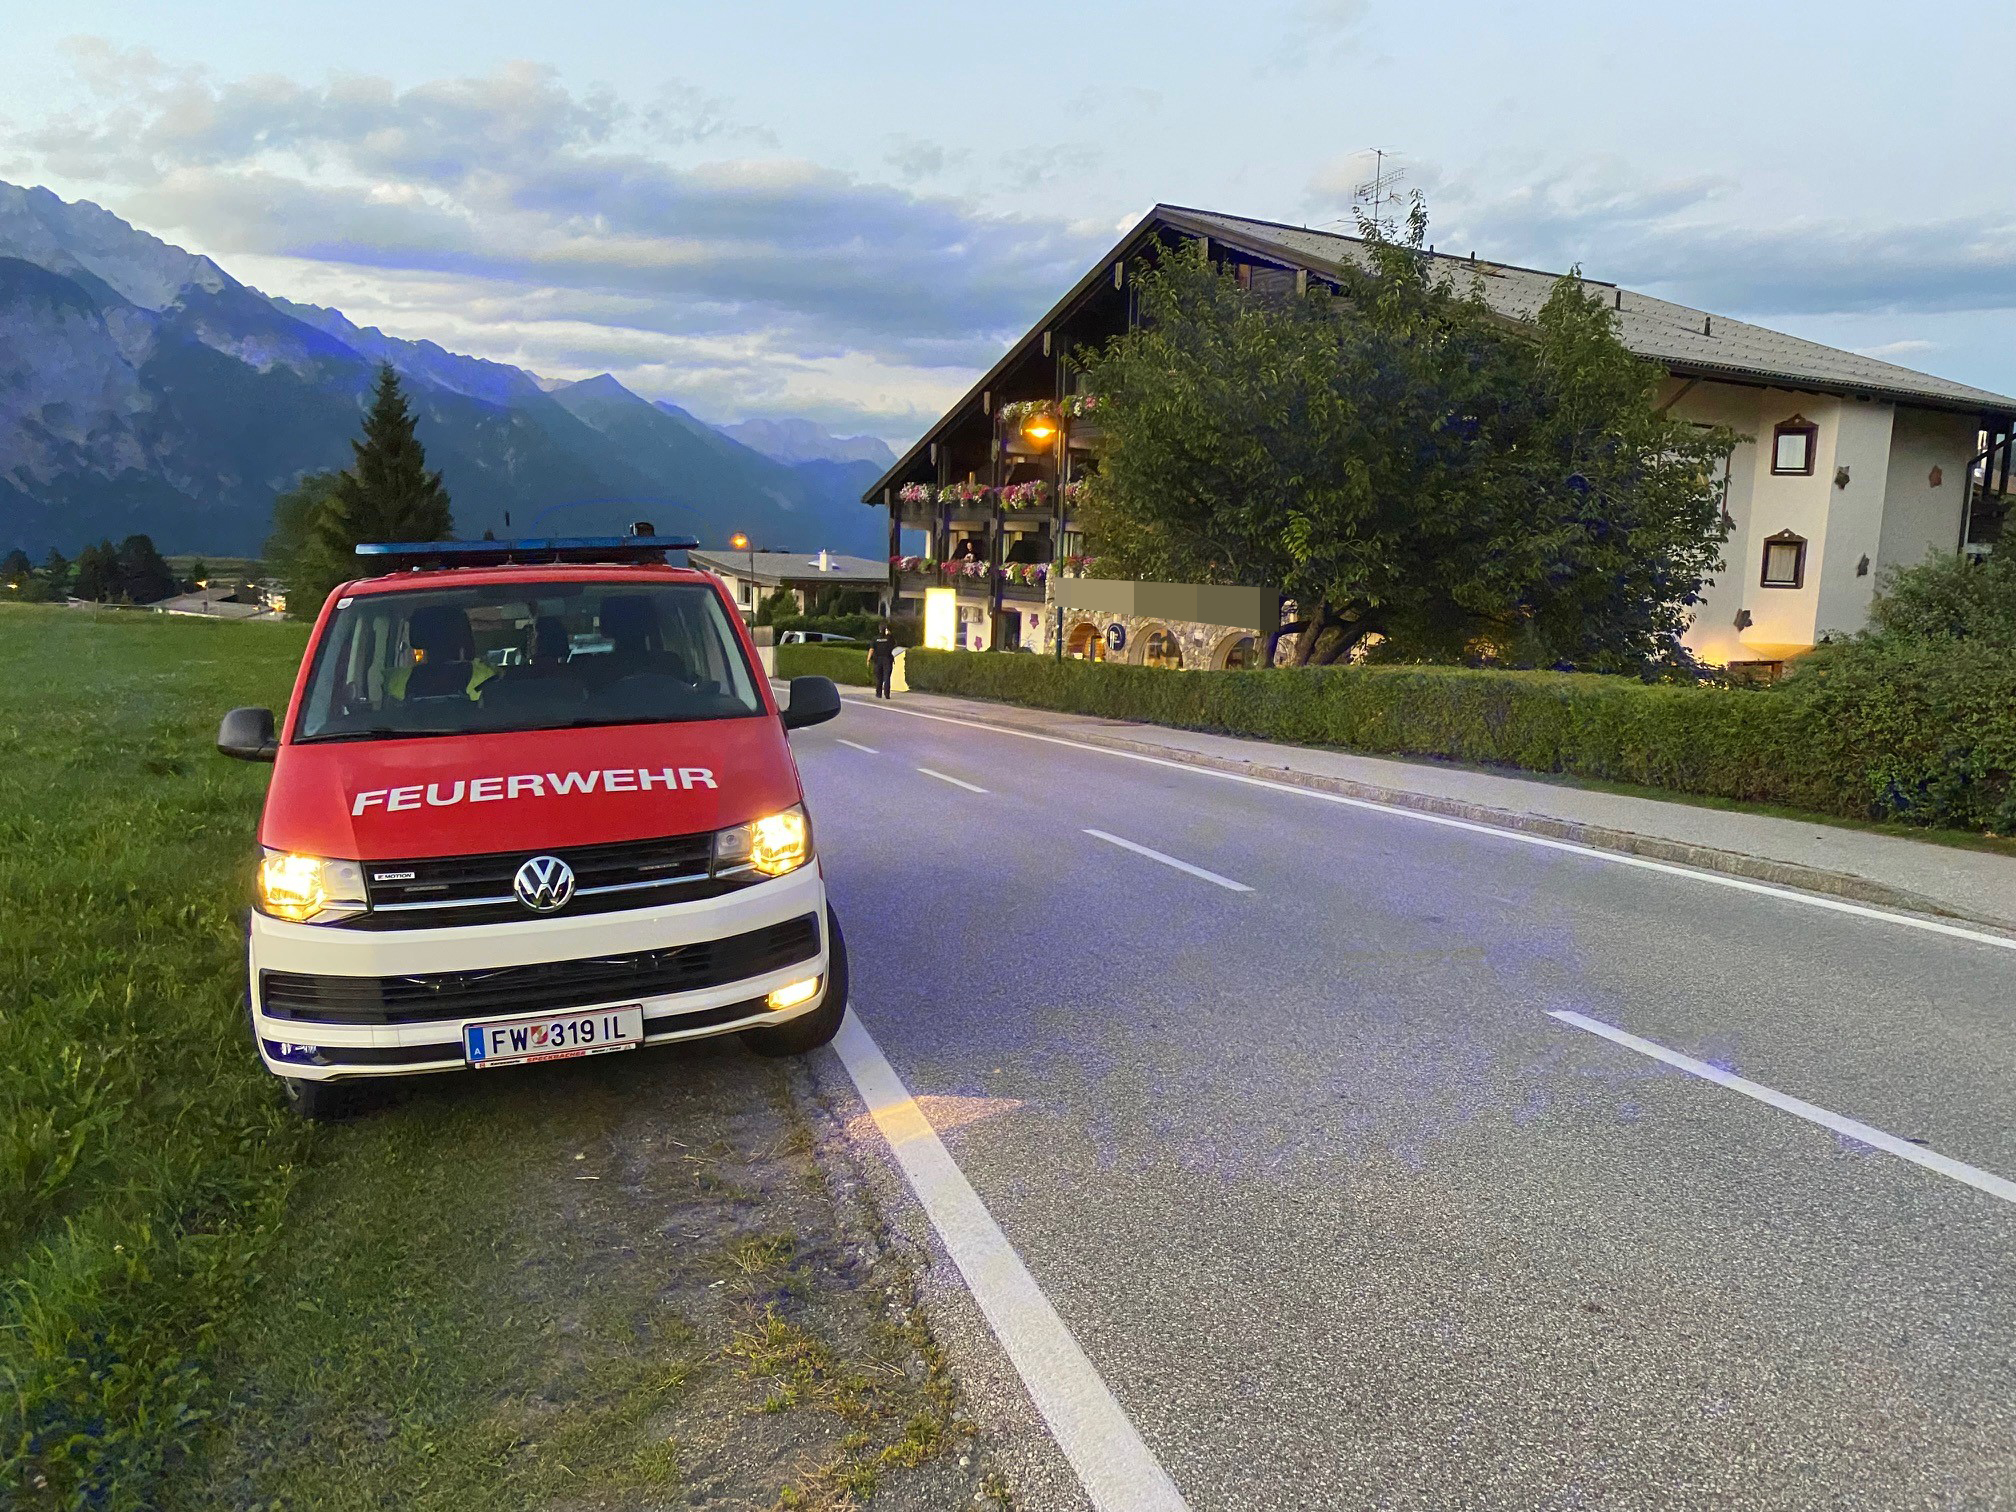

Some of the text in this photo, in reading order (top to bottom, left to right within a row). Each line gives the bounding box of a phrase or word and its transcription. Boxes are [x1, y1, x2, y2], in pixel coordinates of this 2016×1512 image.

[351, 768, 718, 816] FEUERWEHR
[473, 1047, 482, 1056] A
[491, 1016, 626, 1054] FW 319 IL
